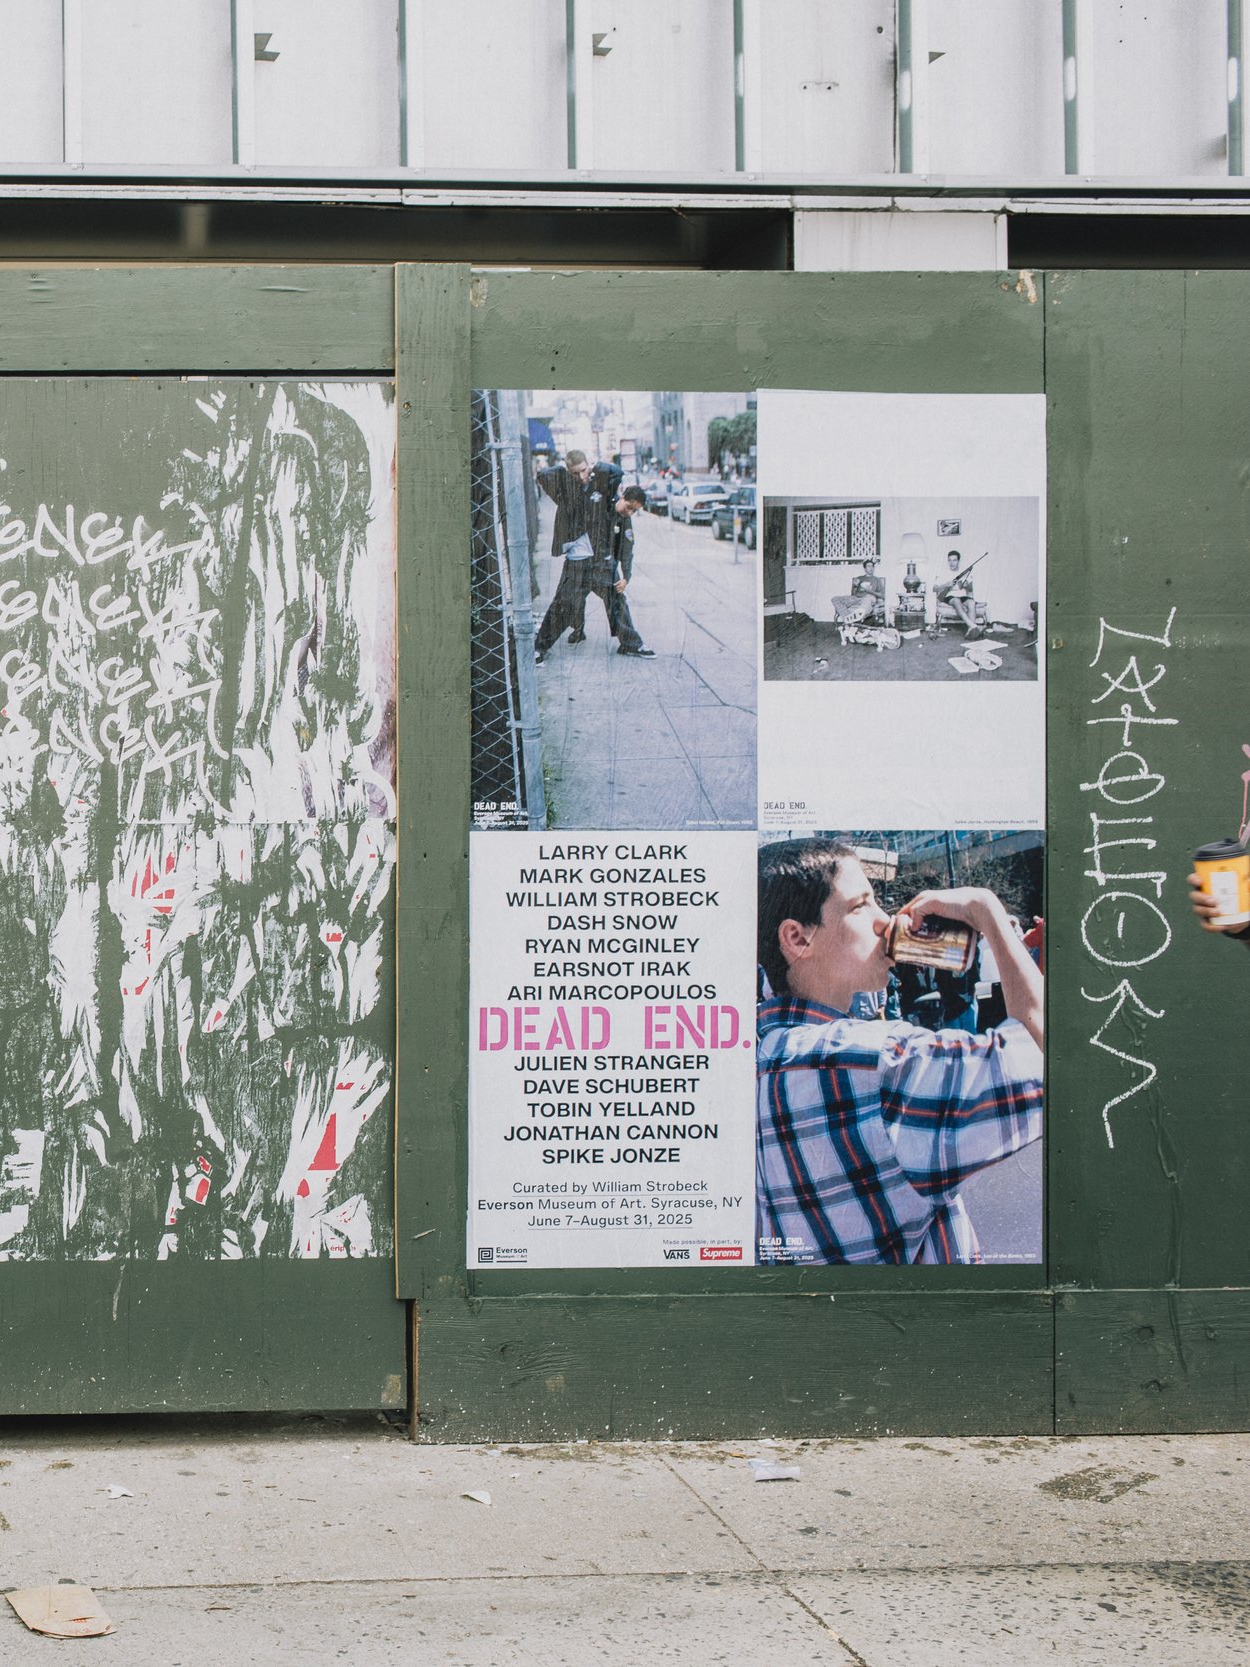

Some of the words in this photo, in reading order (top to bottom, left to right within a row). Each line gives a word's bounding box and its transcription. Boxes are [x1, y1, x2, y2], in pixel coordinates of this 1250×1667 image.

[474, 802, 496, 810] DEAD
[500, 802, 519, 810] END.
[540, 845, 608, 860] LARRY
[615, 845, 687, 860] CLARK
[521, 869, 583, 883] MARK
[590, 868, 706, 883] GONZALES
[506, 892, 596, 906] WILLIAM
[604, 892, 718, 906] STROBECK
[548, 915, 605, 930] DASH
[613, 915, 677, 930] SNOW
[526, 939, 580, 953] RYAN
[589, 938, 699, 953] MCGINLEY
[534, 962, 634, 977] EARSNOT
[642, 962, 690, 976] IRAK
[508, 986, 541, 1000] ARI
[550, 985, 716, 1000] MARCOPOULOS
[478, 1005, 610, 1051] DEAD
[644, 1005, 751, 1051] END.
[515, 1056, 586, 1071] JULIEN
[594, 1055, 709, 1070] STRANGER
[524, 1080, 579, 1094] DAVE
[586, 1078, 700, 1093] SCHUBERT
[527, 1103, 591, 1117] TOBIN
[599, 1102, 695, 1116] YELLAND
[504, 1126, 619, 1141] JONATHAN
[627, 1124, 718, 1140] CANNON
[543, 1149, 603, 1164] SPIKE
[611, 1148, 680, 1163] JONZE
[512, 1181, 567, 1193] Curated
[572, 1181, 587, 1195] by
[592, 1181, 642, 1192] William
[646, 1180, 708, 1192] Strobeck
[478, 1200, 533, 1210] Everson
[538, 1199, 597, 1210] Museum
[601, 1198, 615, 1209] of
[620, 1198, 646, 1209] Art.
[651, 1197, 718, 1210] Syracuse,
[722, 1197, 742, 1208] NY
[528, 1215, 561, 1227] June
[634, 1215, 653, 1226] 31,
[658, 1214, 693, 1225] 2025
[663, 1249, 690, 1260] VANS
[702, 1248, 740, 1259] Supreme
